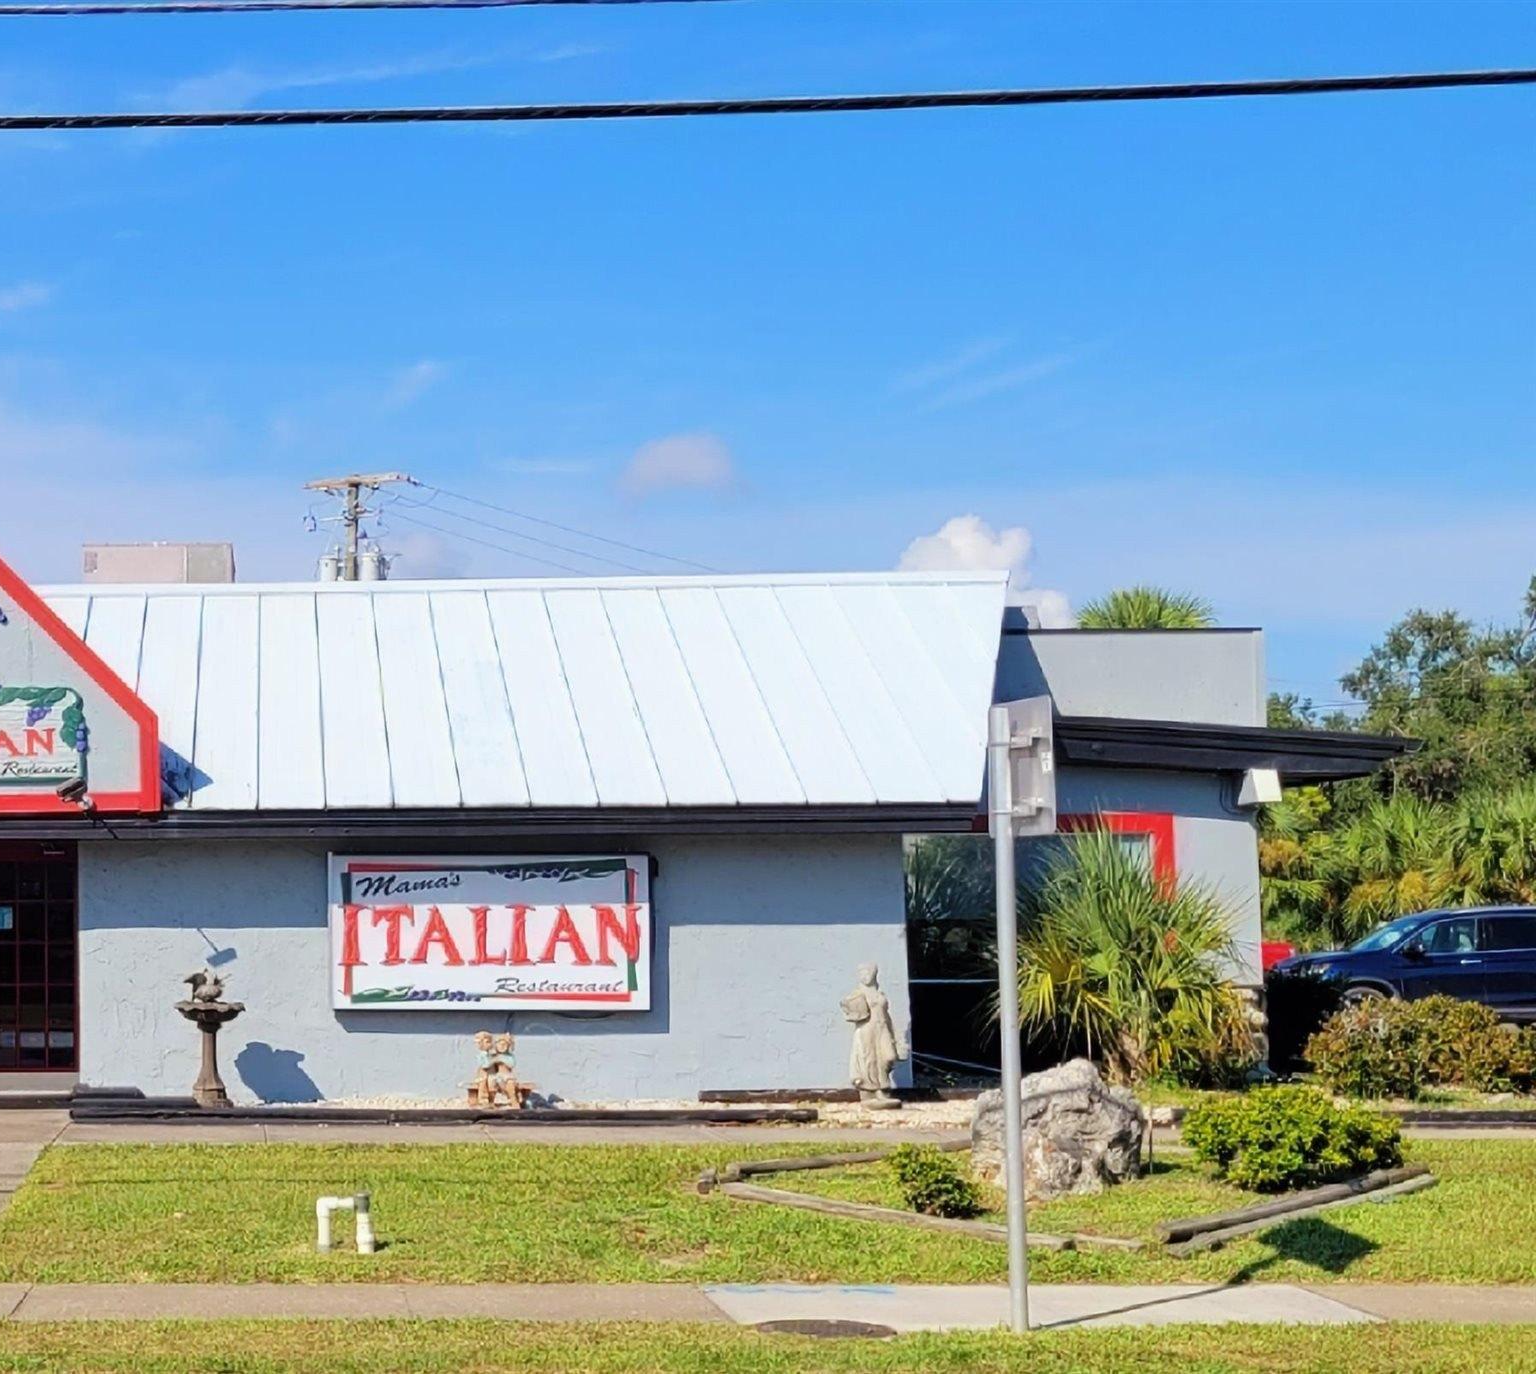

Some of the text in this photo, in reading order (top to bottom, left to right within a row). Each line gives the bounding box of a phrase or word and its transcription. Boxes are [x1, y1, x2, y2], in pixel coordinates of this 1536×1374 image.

[1, 760, 79, 776] Restaurant
[356, 872, 464, 898] Mama's
[338, 903, 643, 967] ITALIAN
[494, 977, 624, 993] Restaurant
